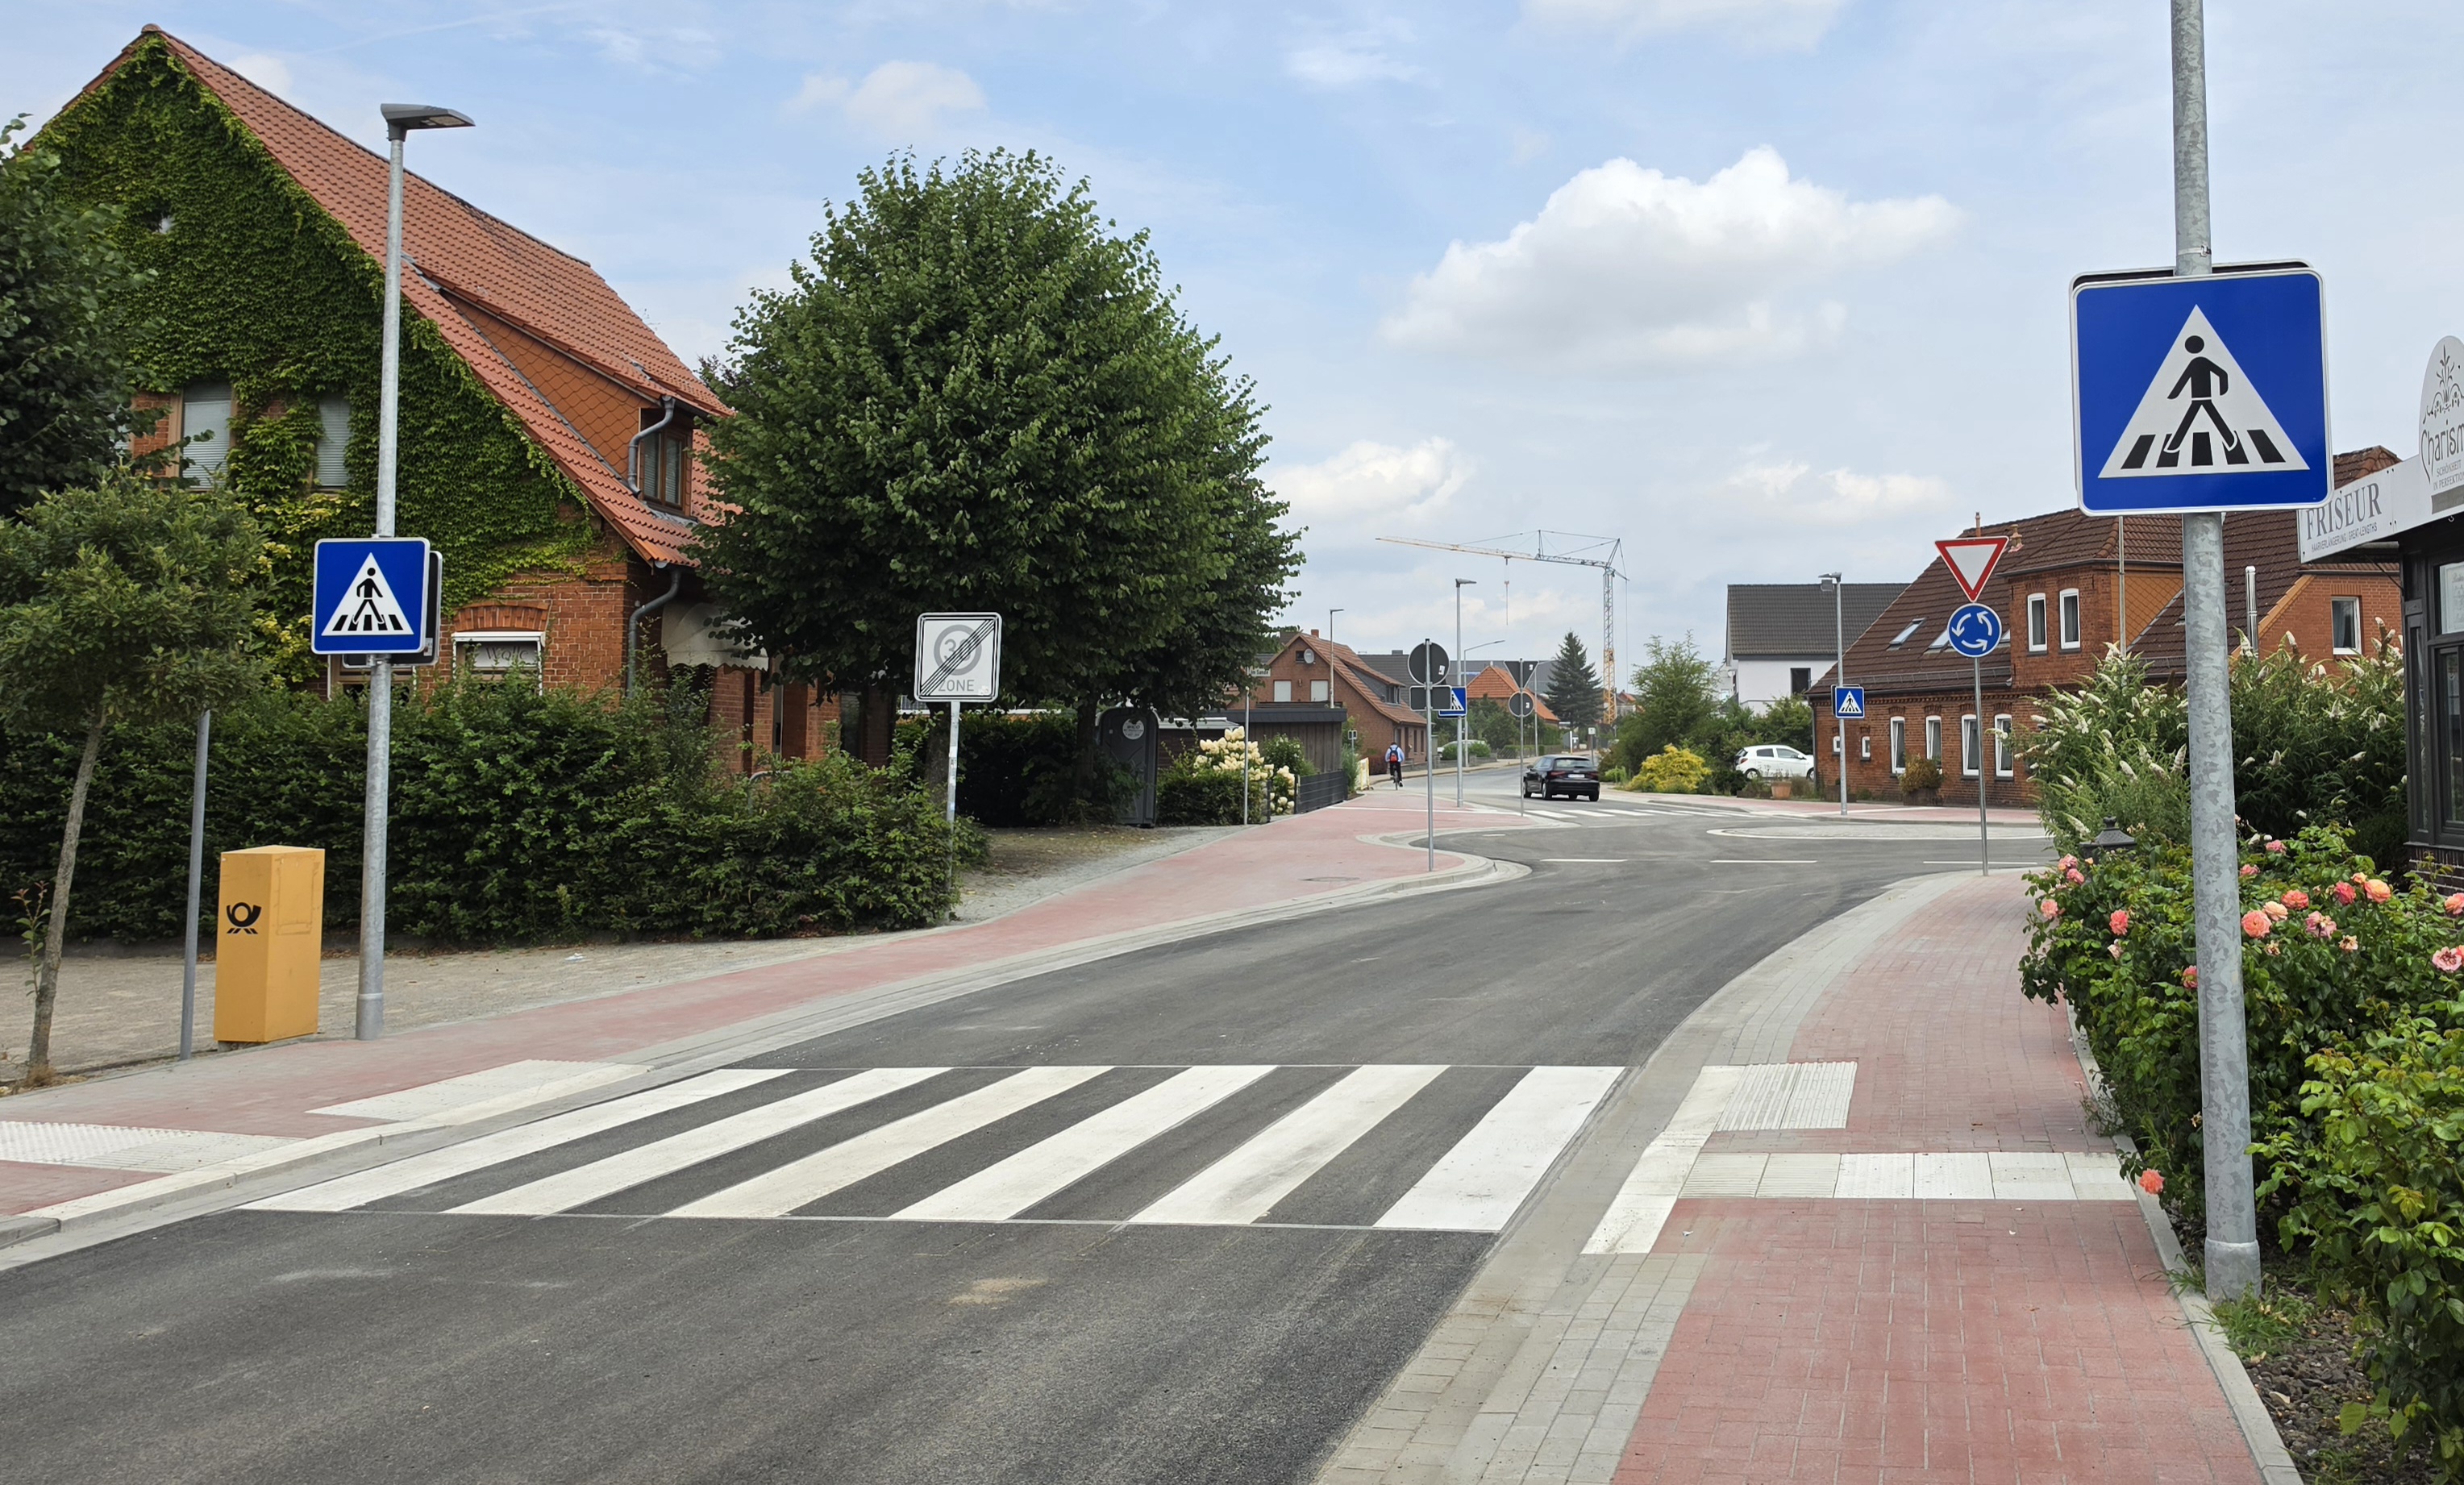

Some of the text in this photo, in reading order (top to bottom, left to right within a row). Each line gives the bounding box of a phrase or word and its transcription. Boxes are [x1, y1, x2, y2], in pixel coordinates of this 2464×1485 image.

[2437, 459, 2462, 477] SCHÖNHEIT
[2306, 483, 2382, 541] FRISEUR
[938, 679, 975, 692] ZONE
